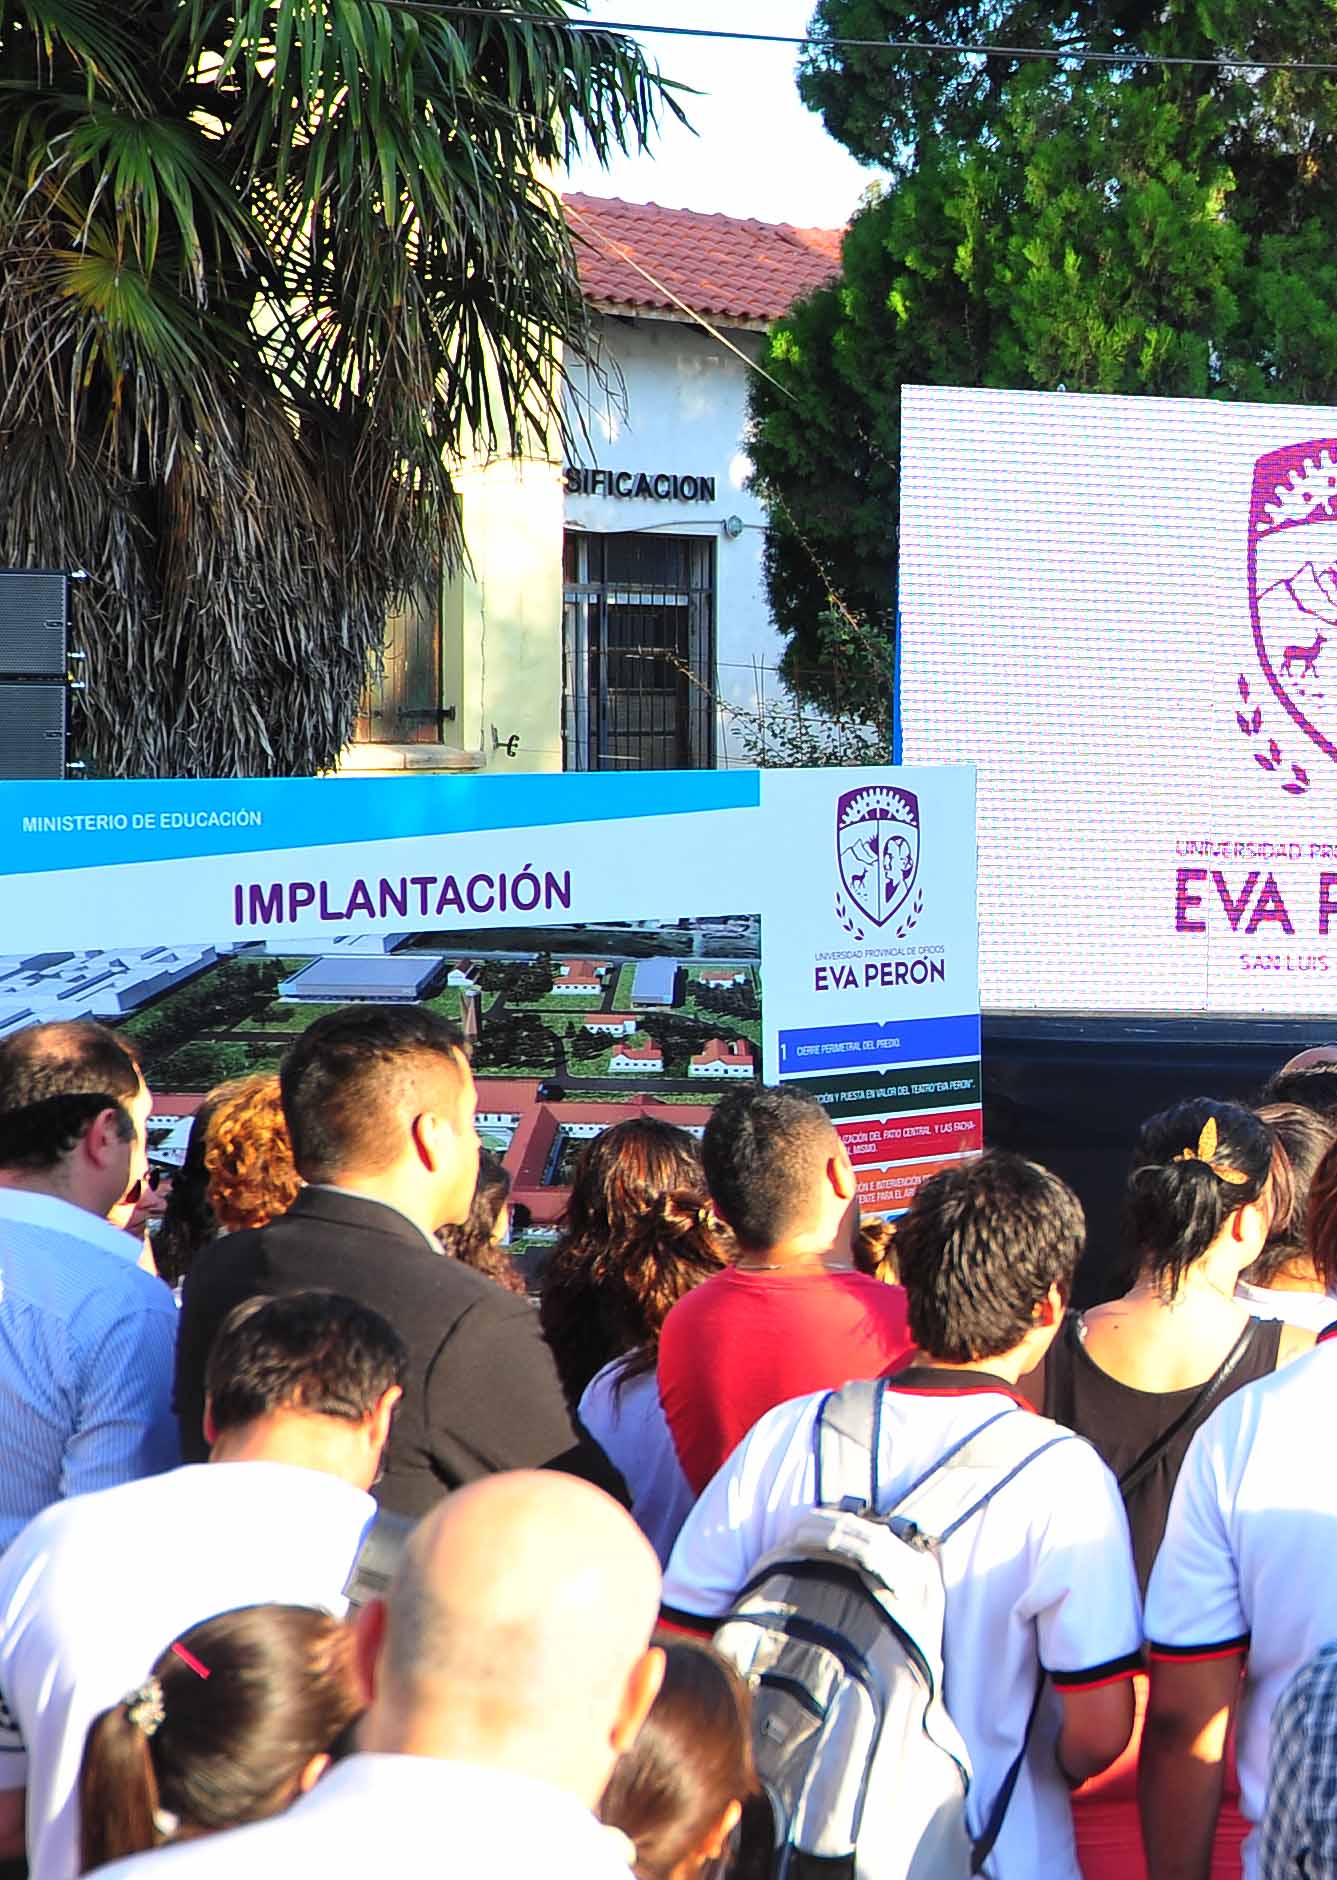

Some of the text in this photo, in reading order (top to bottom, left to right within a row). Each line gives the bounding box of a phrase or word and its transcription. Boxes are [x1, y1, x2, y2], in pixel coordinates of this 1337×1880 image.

[23, 807, 262, 832] MINISTERIO DE EDUCACIÓN
[1175, 840, 1302, 860] UNIVERSIDAD
[234, 863, 572, 926] IMPLANTACIÓN
[1175, 868, 1296, 934] EVA
[814, 950, 864, 961] UNIVERSIDAD
[906, 946, 917, 956] DE
[1239, 953, 1281, 971] SAN
[1286, 955, 1329, 971] LUIS
[815, 955, 945, 992] EVA PERÓN
[780, 1043, 787, 1061] 1
[862, 1039, 876, 1051] DEL
[840, 1089, 865, 1102] PUESTA
[865, 1089, 875, 1099] EN
[875, 1086, 897, 1098] VALOR
[897, 1085, 911, 1096] DEL
[869, 1130, 882, 1141] DEL
[883, 1128, 901, 1139] PATIO
[903, 1126, 932, 1138] CENTRAL
[940, 1122, 953, 1133] LAS
